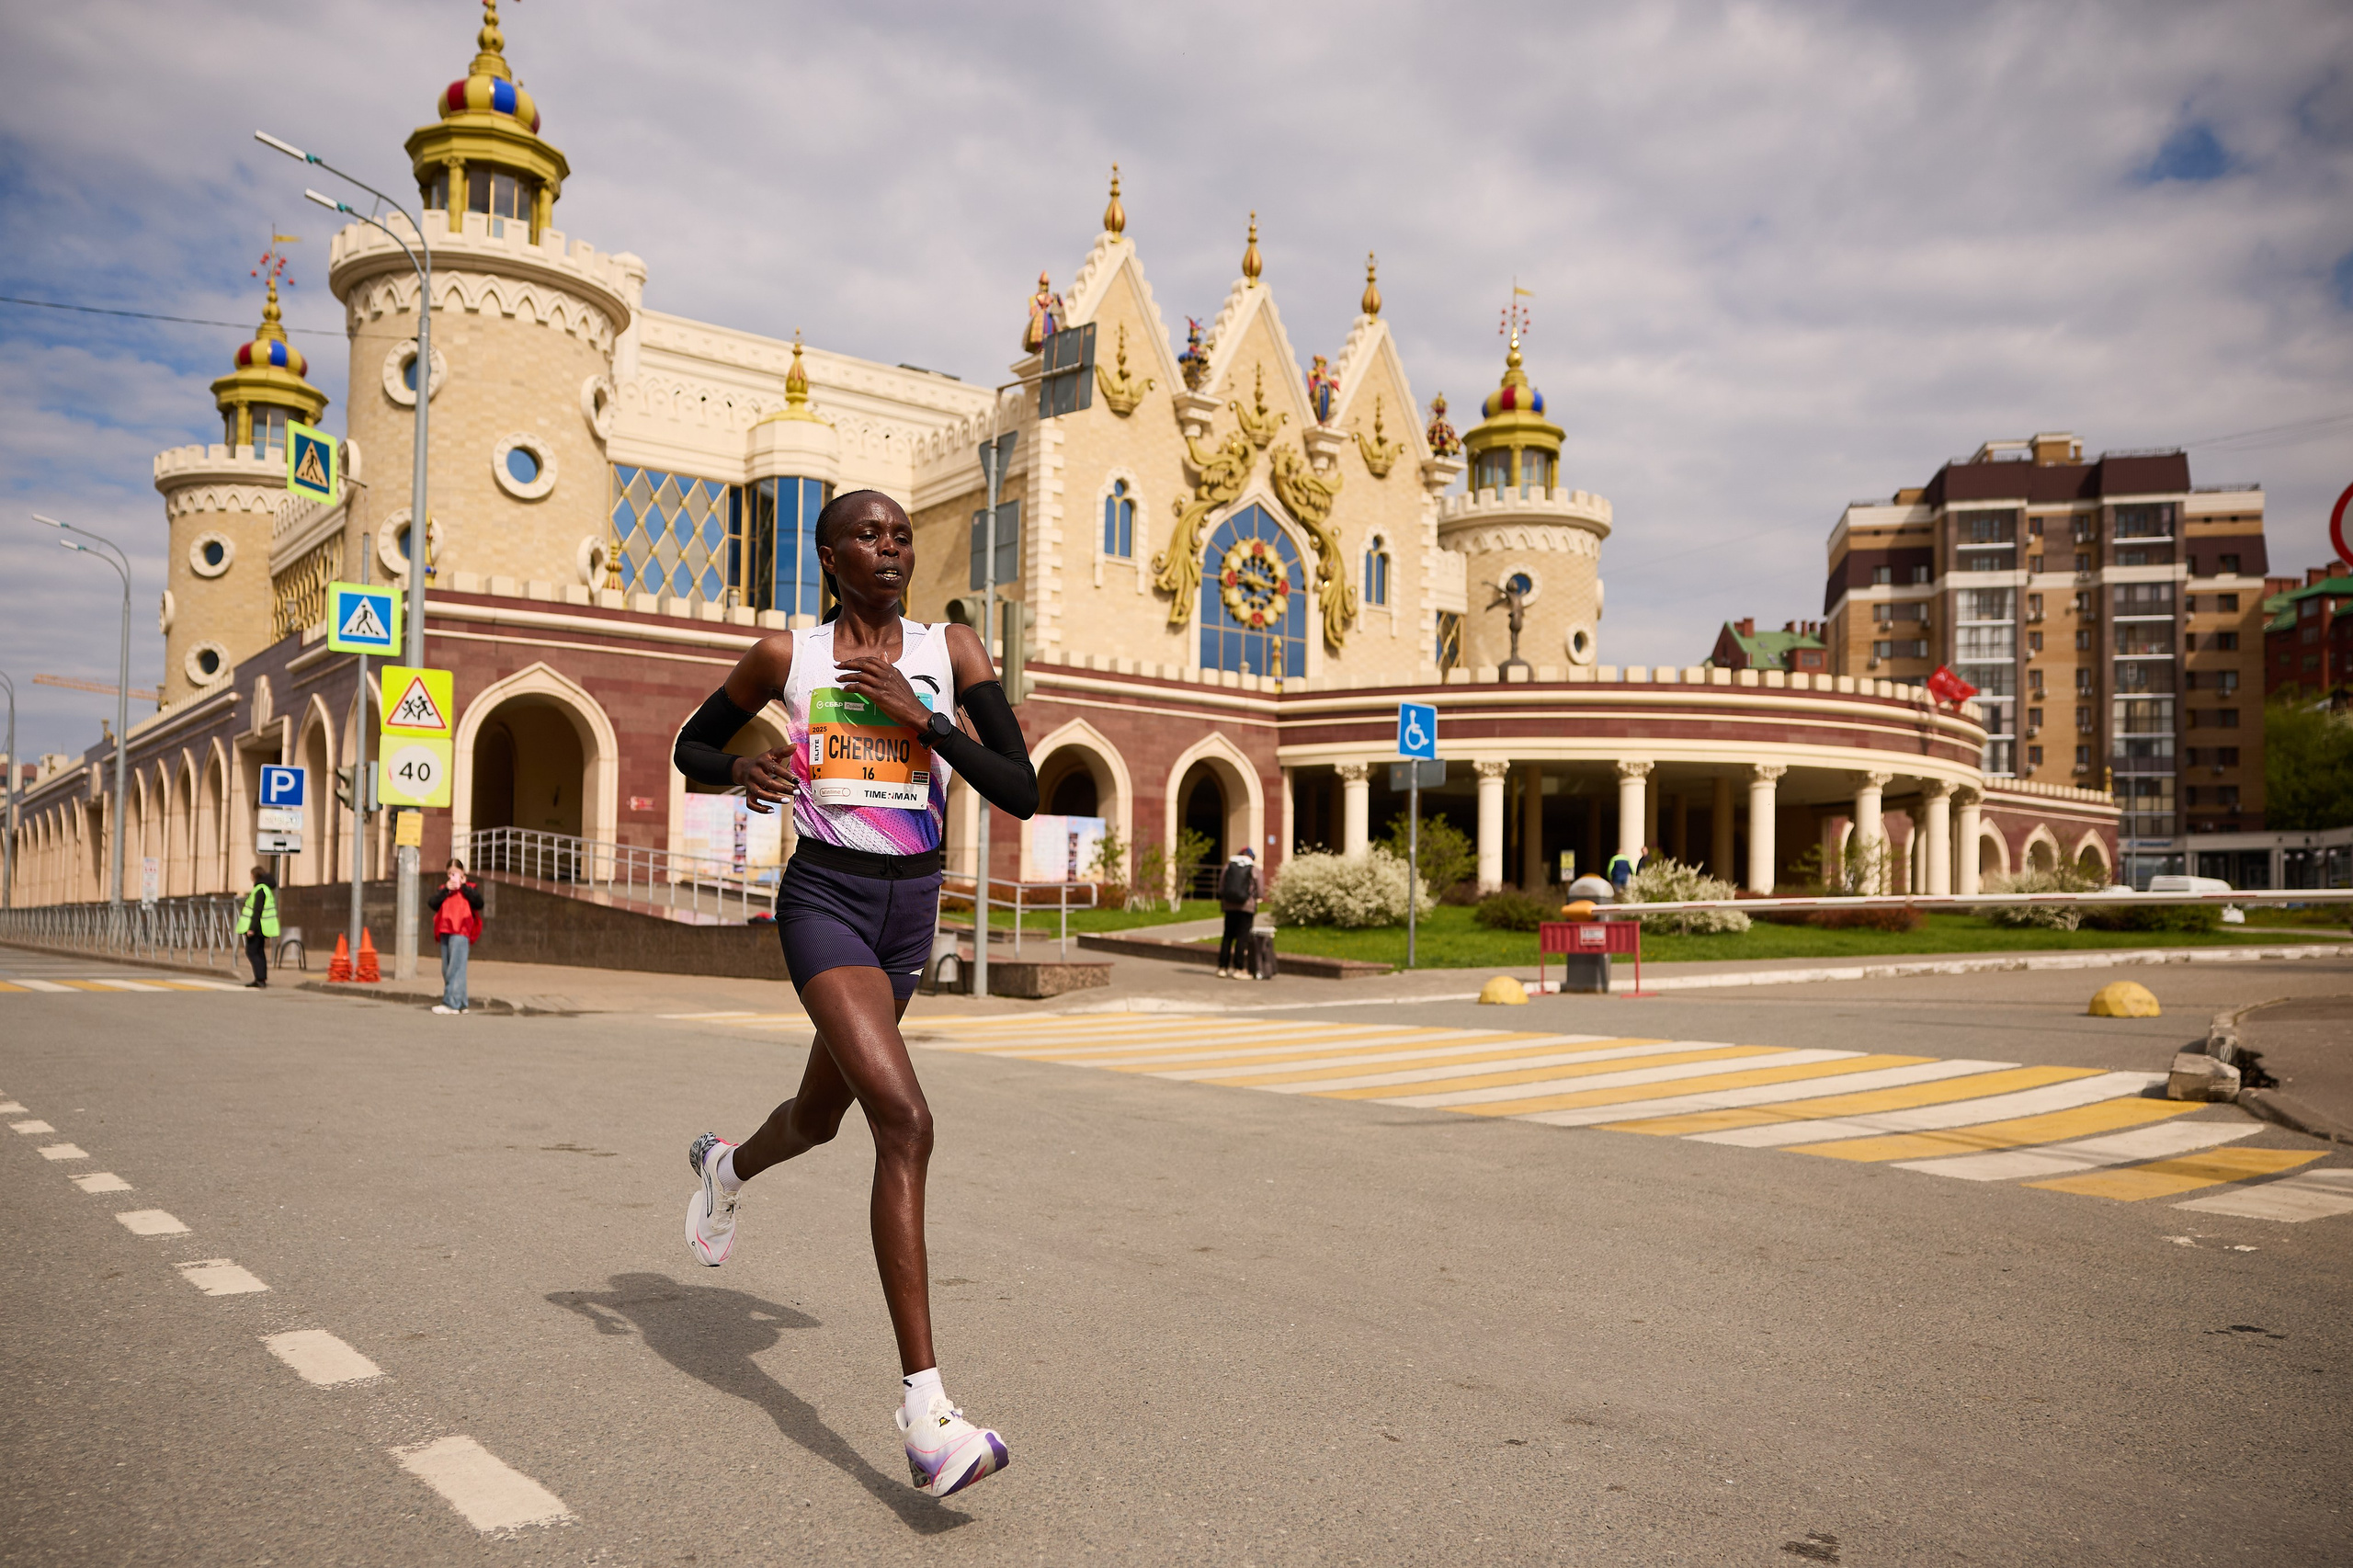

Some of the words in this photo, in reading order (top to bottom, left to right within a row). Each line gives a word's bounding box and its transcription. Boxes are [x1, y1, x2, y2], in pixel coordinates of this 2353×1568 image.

[828, 734, 910, 764] CHERONO
[399, 761, 430, 781] 40
[862, 767, 875, 780] 16
[269, 769, 296, 803] P
